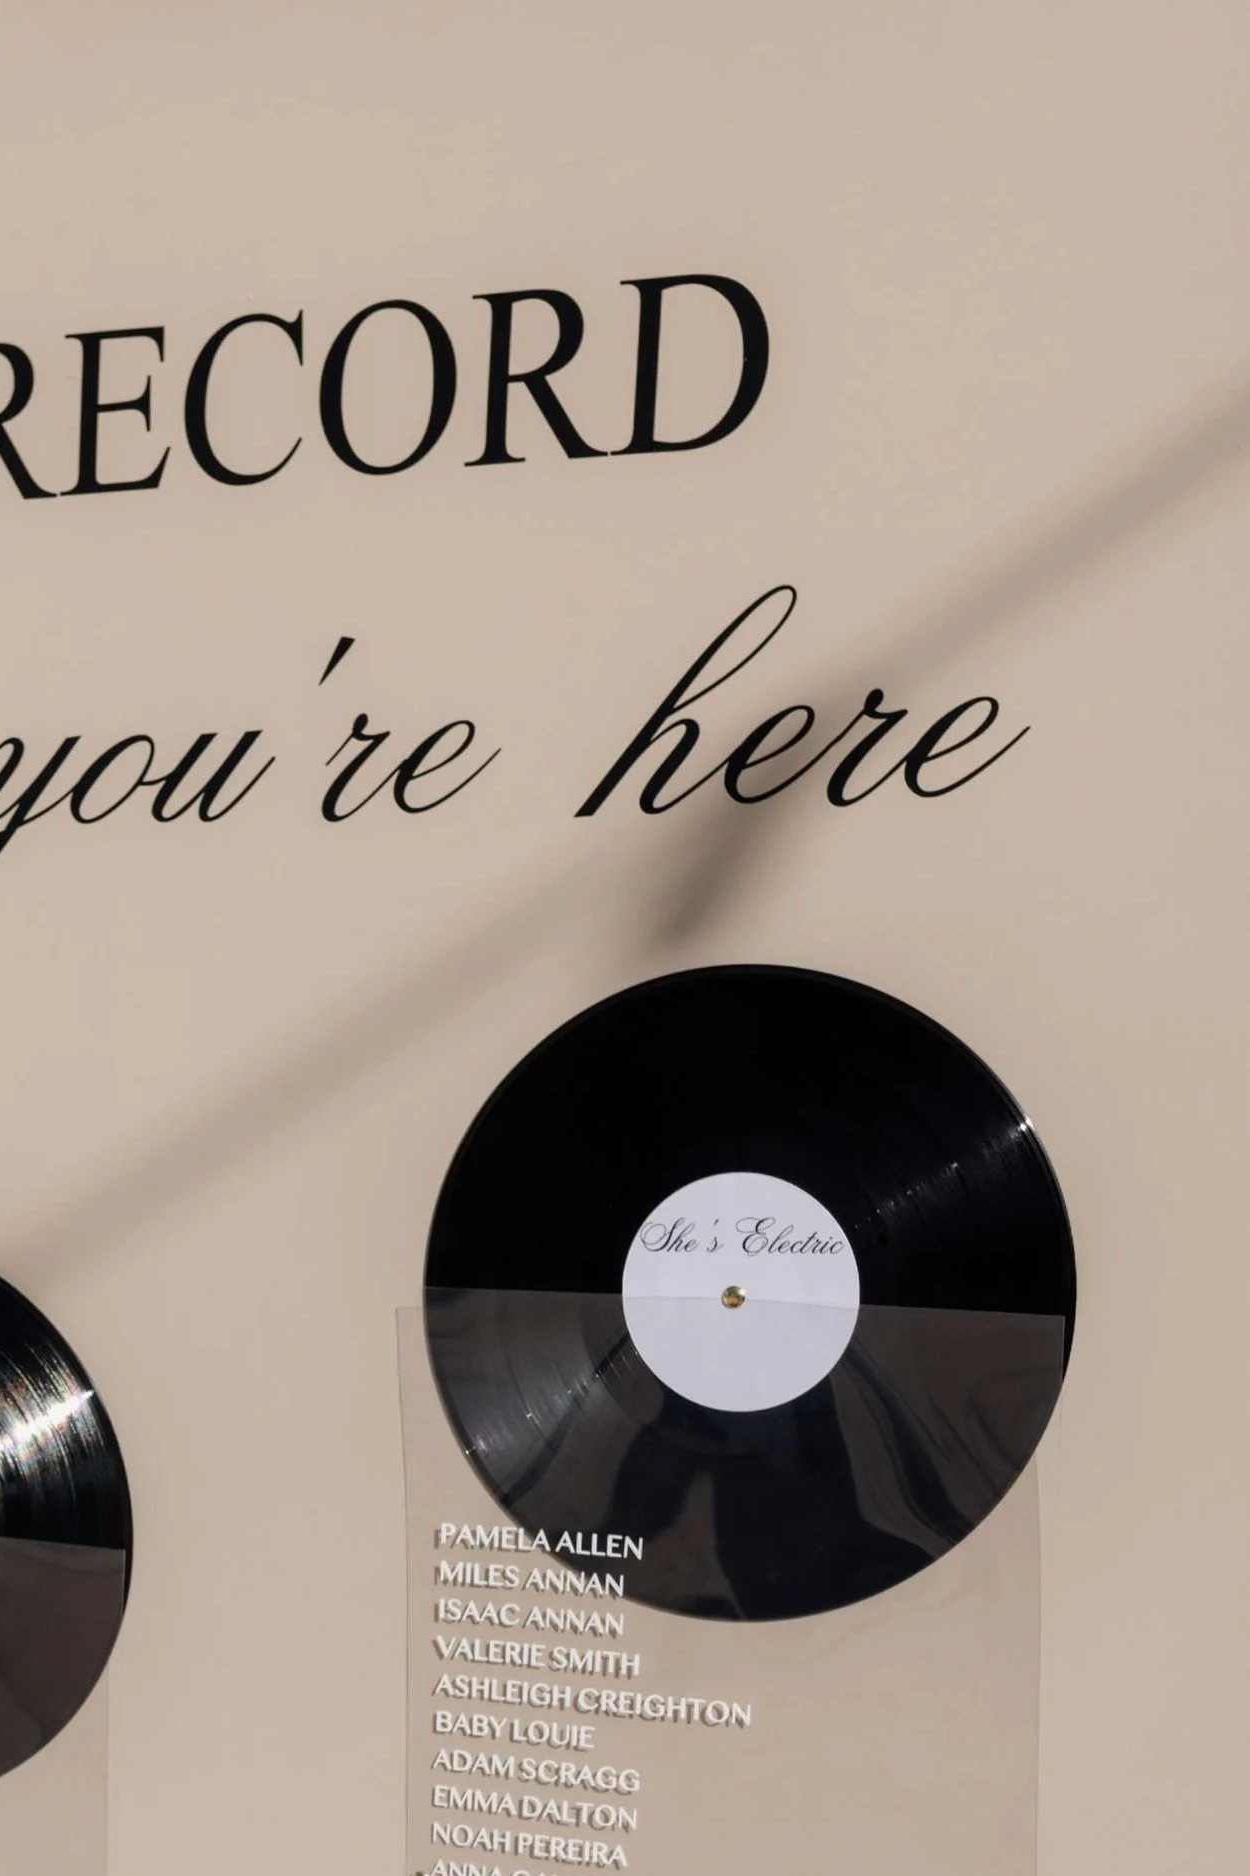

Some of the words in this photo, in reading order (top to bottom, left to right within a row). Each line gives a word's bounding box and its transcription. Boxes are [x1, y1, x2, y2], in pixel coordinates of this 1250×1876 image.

[574, 585, 1031, 818] here
[736, 1217, 845, 1257] Electric
[440, 1523, 550, 1552] PAMELA
[556, 1531, 644, 1560] ALLEN
[440, 1560, 519, 1588] MILES
[526, 1568, 624, 1597] ANNAN
[439, 1598, 520, 1626] ISAAC
[526, 1607, 624, 1635] ANNAN
[436, 1635, 545, 1667] VALERIE
[553, 1647, 640, 1676] SMITH
[436, 1674, 571, 1708] ASHLEIGH
[579, 1688, 751, 1725] CREIGHTON
[436, 1712, 506, 1738] BABY
[514, 1719, 595, 1748] LOUIE
[433, 1749, 514, 1777] ADAM
[523, 1759, 640, 1792] SCRAGG
[434, 1785, 516, 1814] EMMA
[523, 1796, 637, 1830] DALTON
[432, 1823, 511, 1853] NOAH
[519, 1832, 628, 1867] PEREIRA
